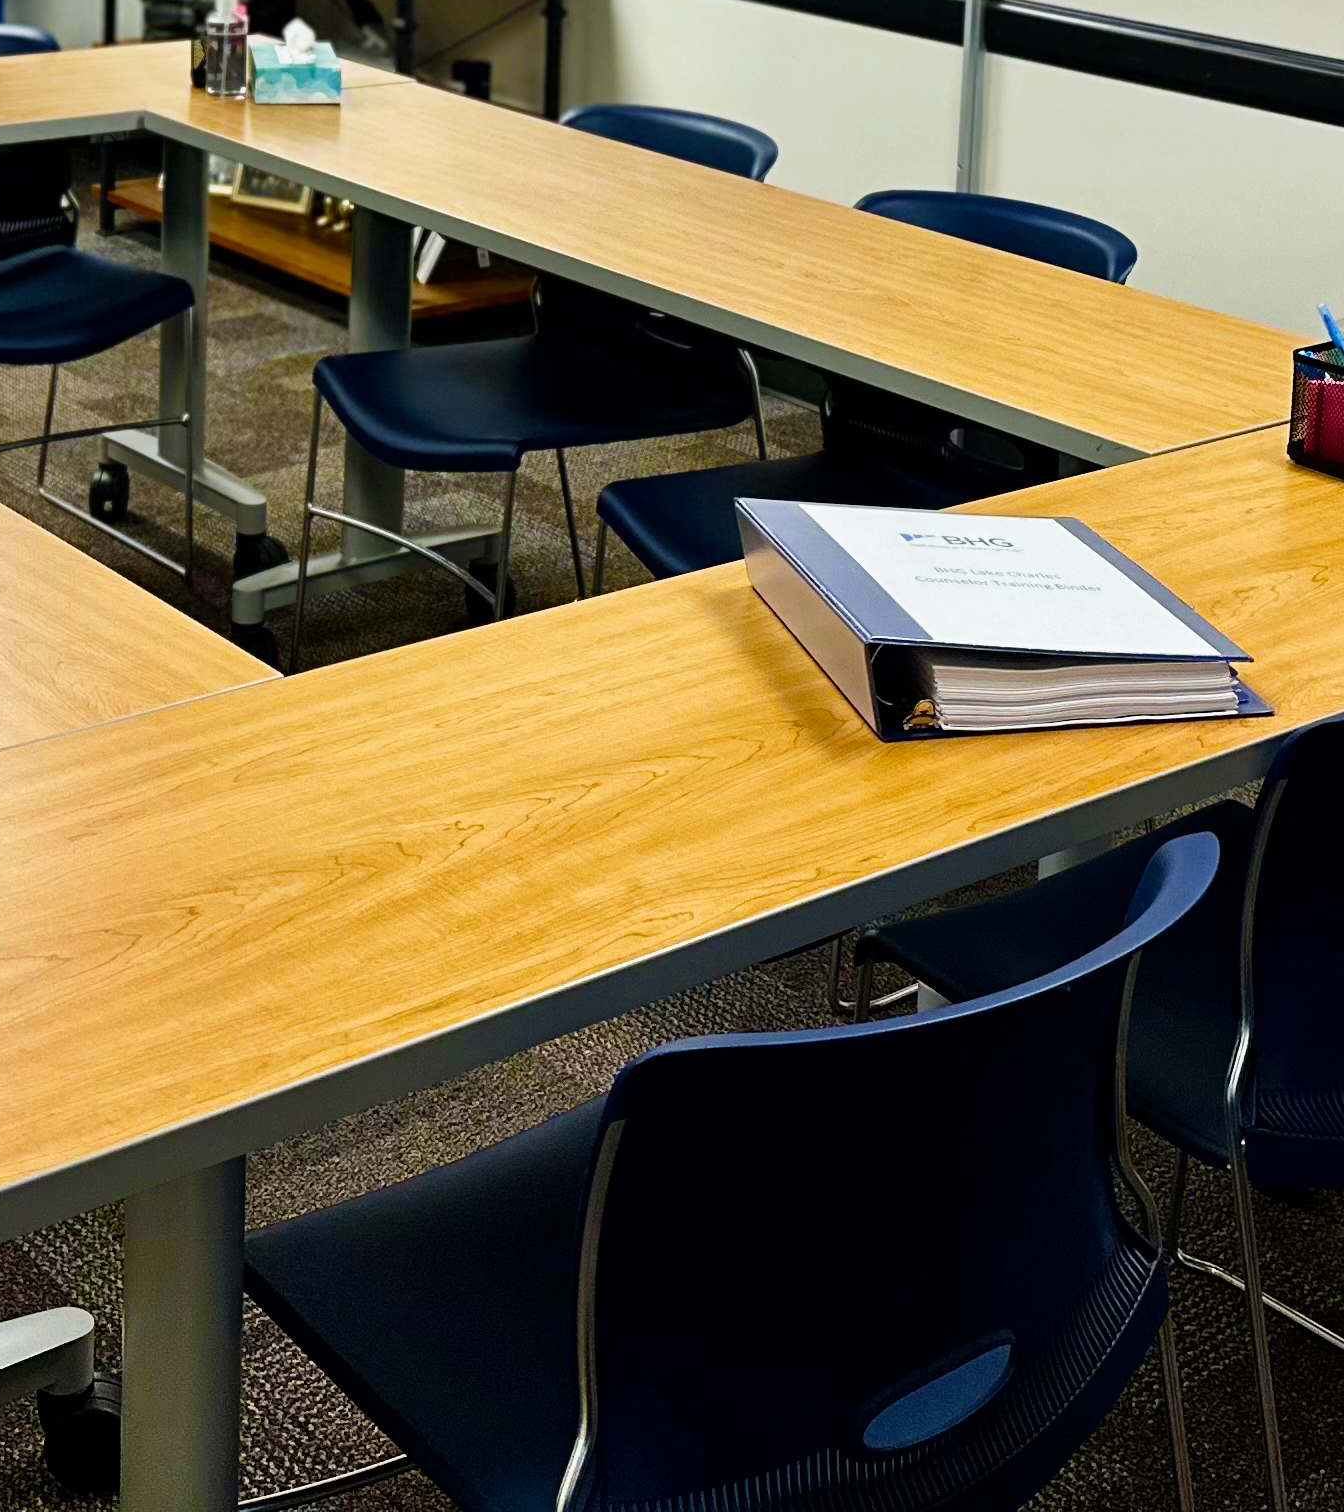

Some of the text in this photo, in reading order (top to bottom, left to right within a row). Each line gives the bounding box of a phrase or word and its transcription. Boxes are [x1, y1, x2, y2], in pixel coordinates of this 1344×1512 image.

[940, 535, 1014, 548] BHG
[970, 568, 1005, 578] Lake
[1006, 570, 1062, 580] Charles
[914, 575, 1102, 592] Counselor Training Binder
